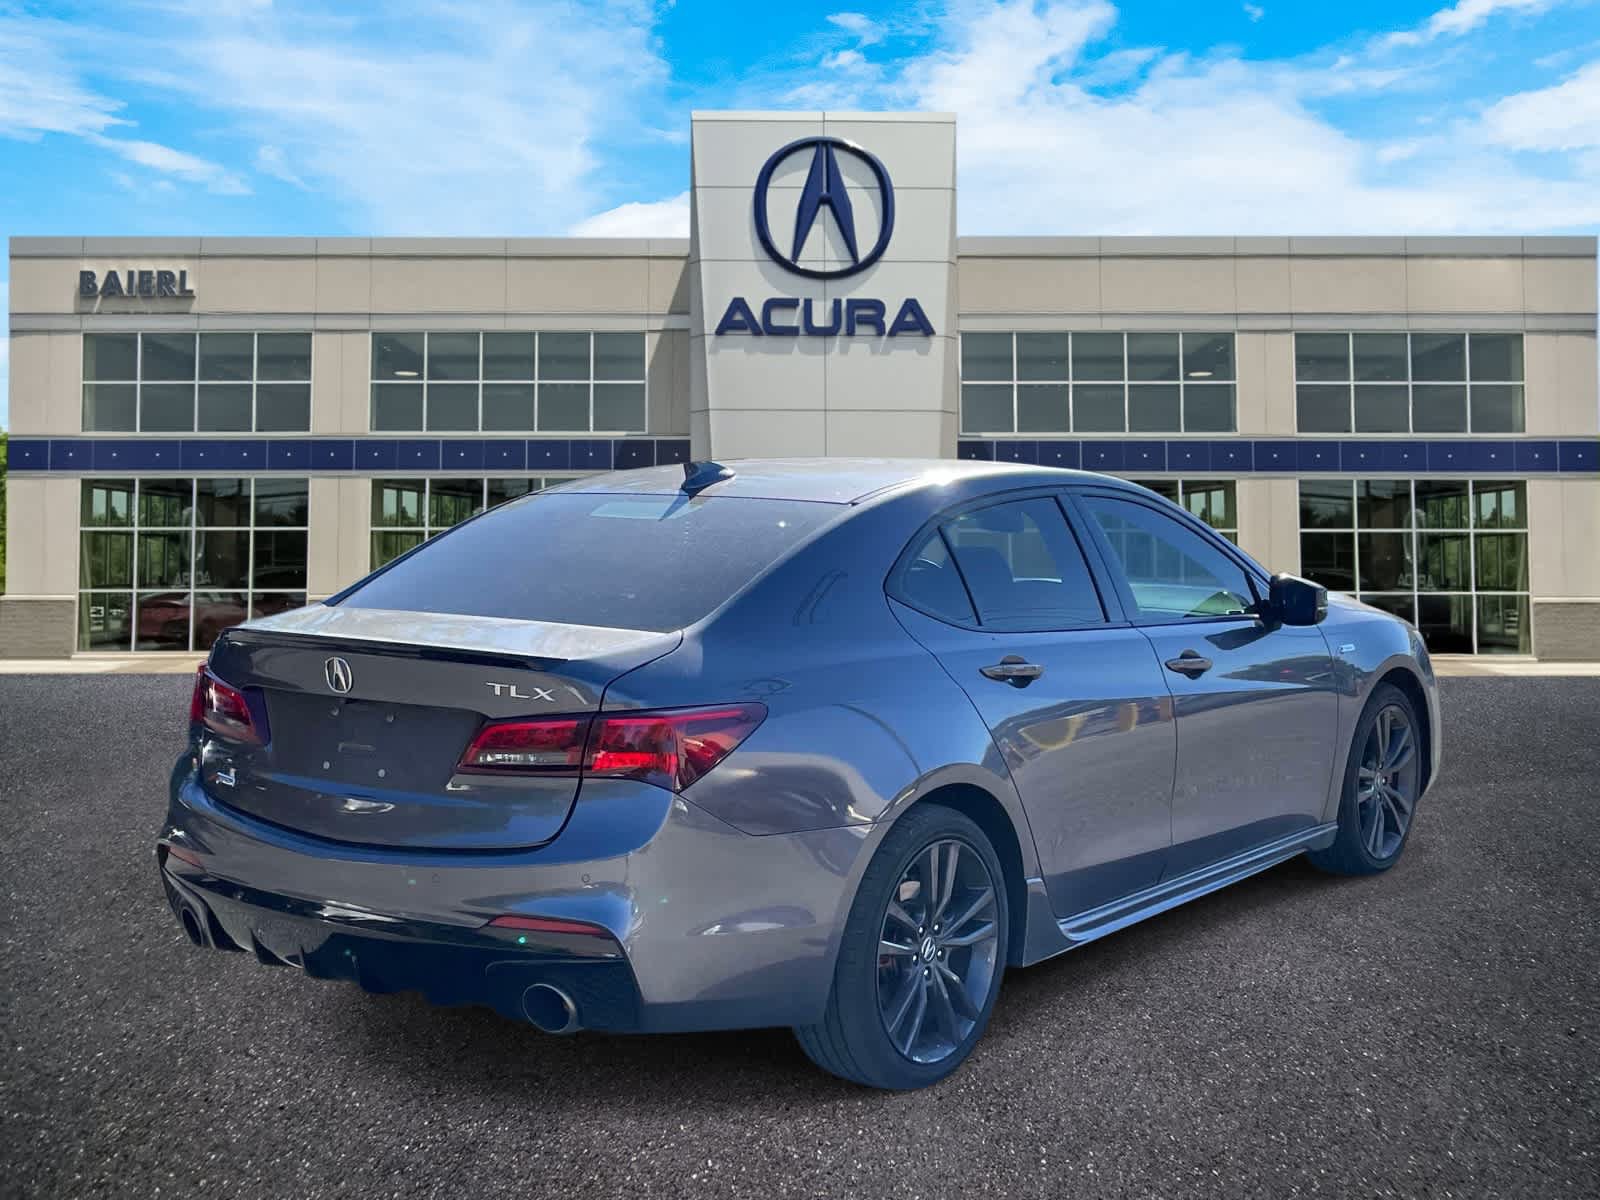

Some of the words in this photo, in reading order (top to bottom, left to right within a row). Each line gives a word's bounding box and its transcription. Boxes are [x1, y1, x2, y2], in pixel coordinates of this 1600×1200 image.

[79, 269, 195, 297] BAIERL
[714, 296, 937, 337] ACURA
[485, 682, 555, 702] TLX
